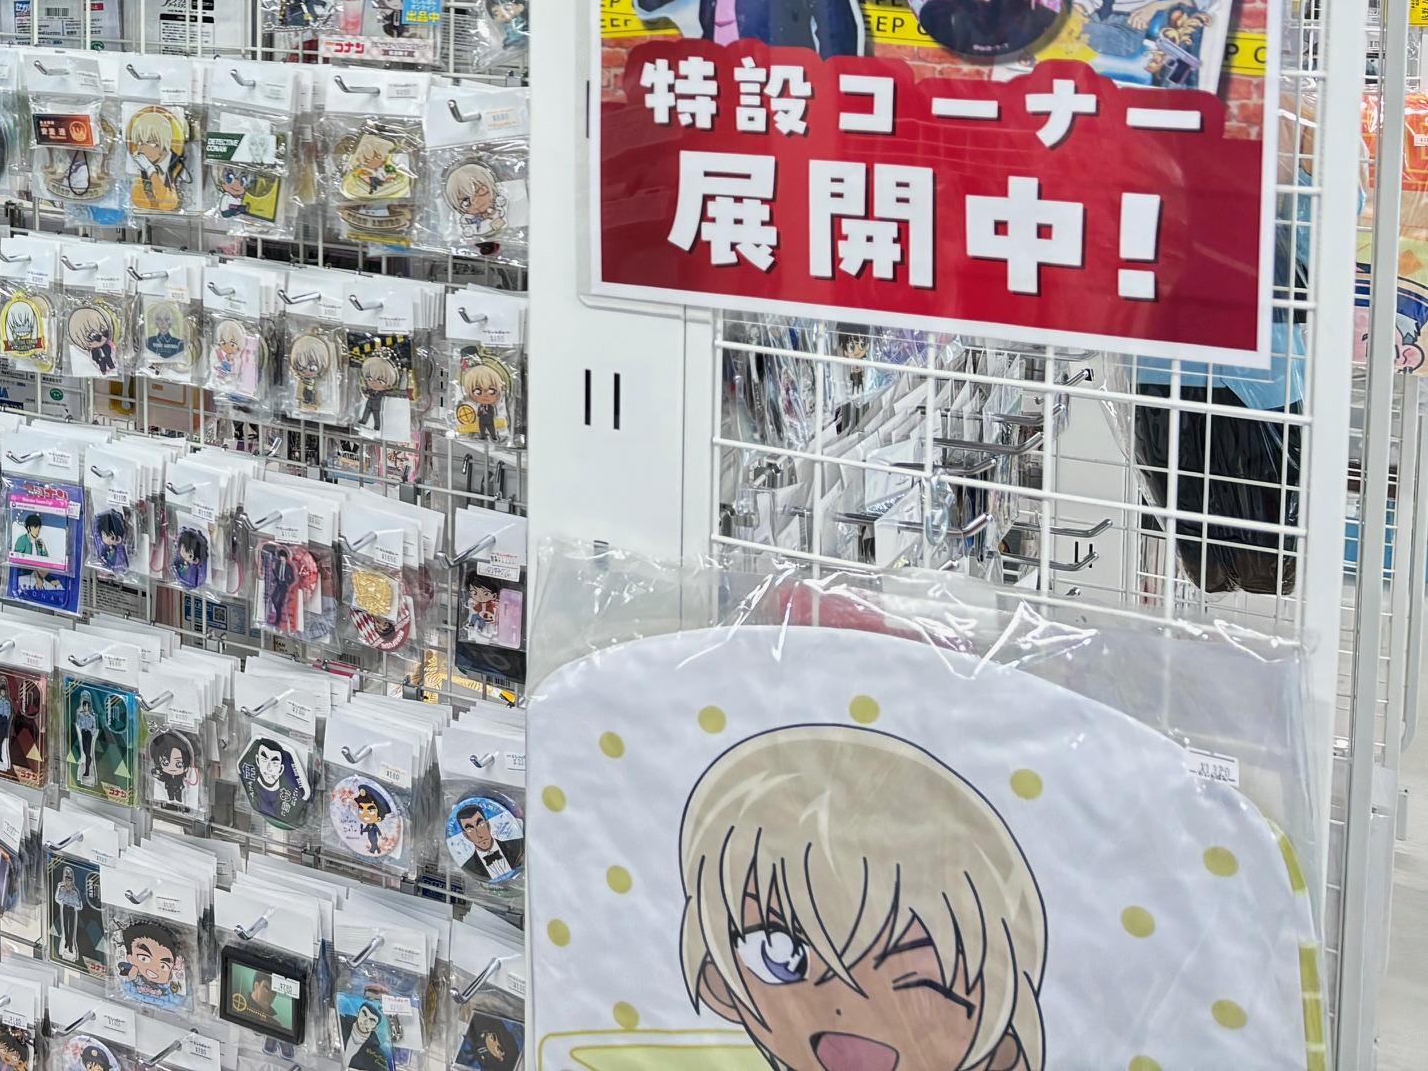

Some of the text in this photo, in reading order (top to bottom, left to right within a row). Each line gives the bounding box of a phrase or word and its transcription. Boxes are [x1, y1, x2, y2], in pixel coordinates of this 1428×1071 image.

[405, 11, 441, 23] 出品中
[333, 42, 365, 55] コナン
[641, 55, 1202, 148] 特設コーナー
[206, 138, 240, 148] DETECTIVE
[206, 144, 228, 154] CONAN
[667, 151, 1162, 302] 展開中!
